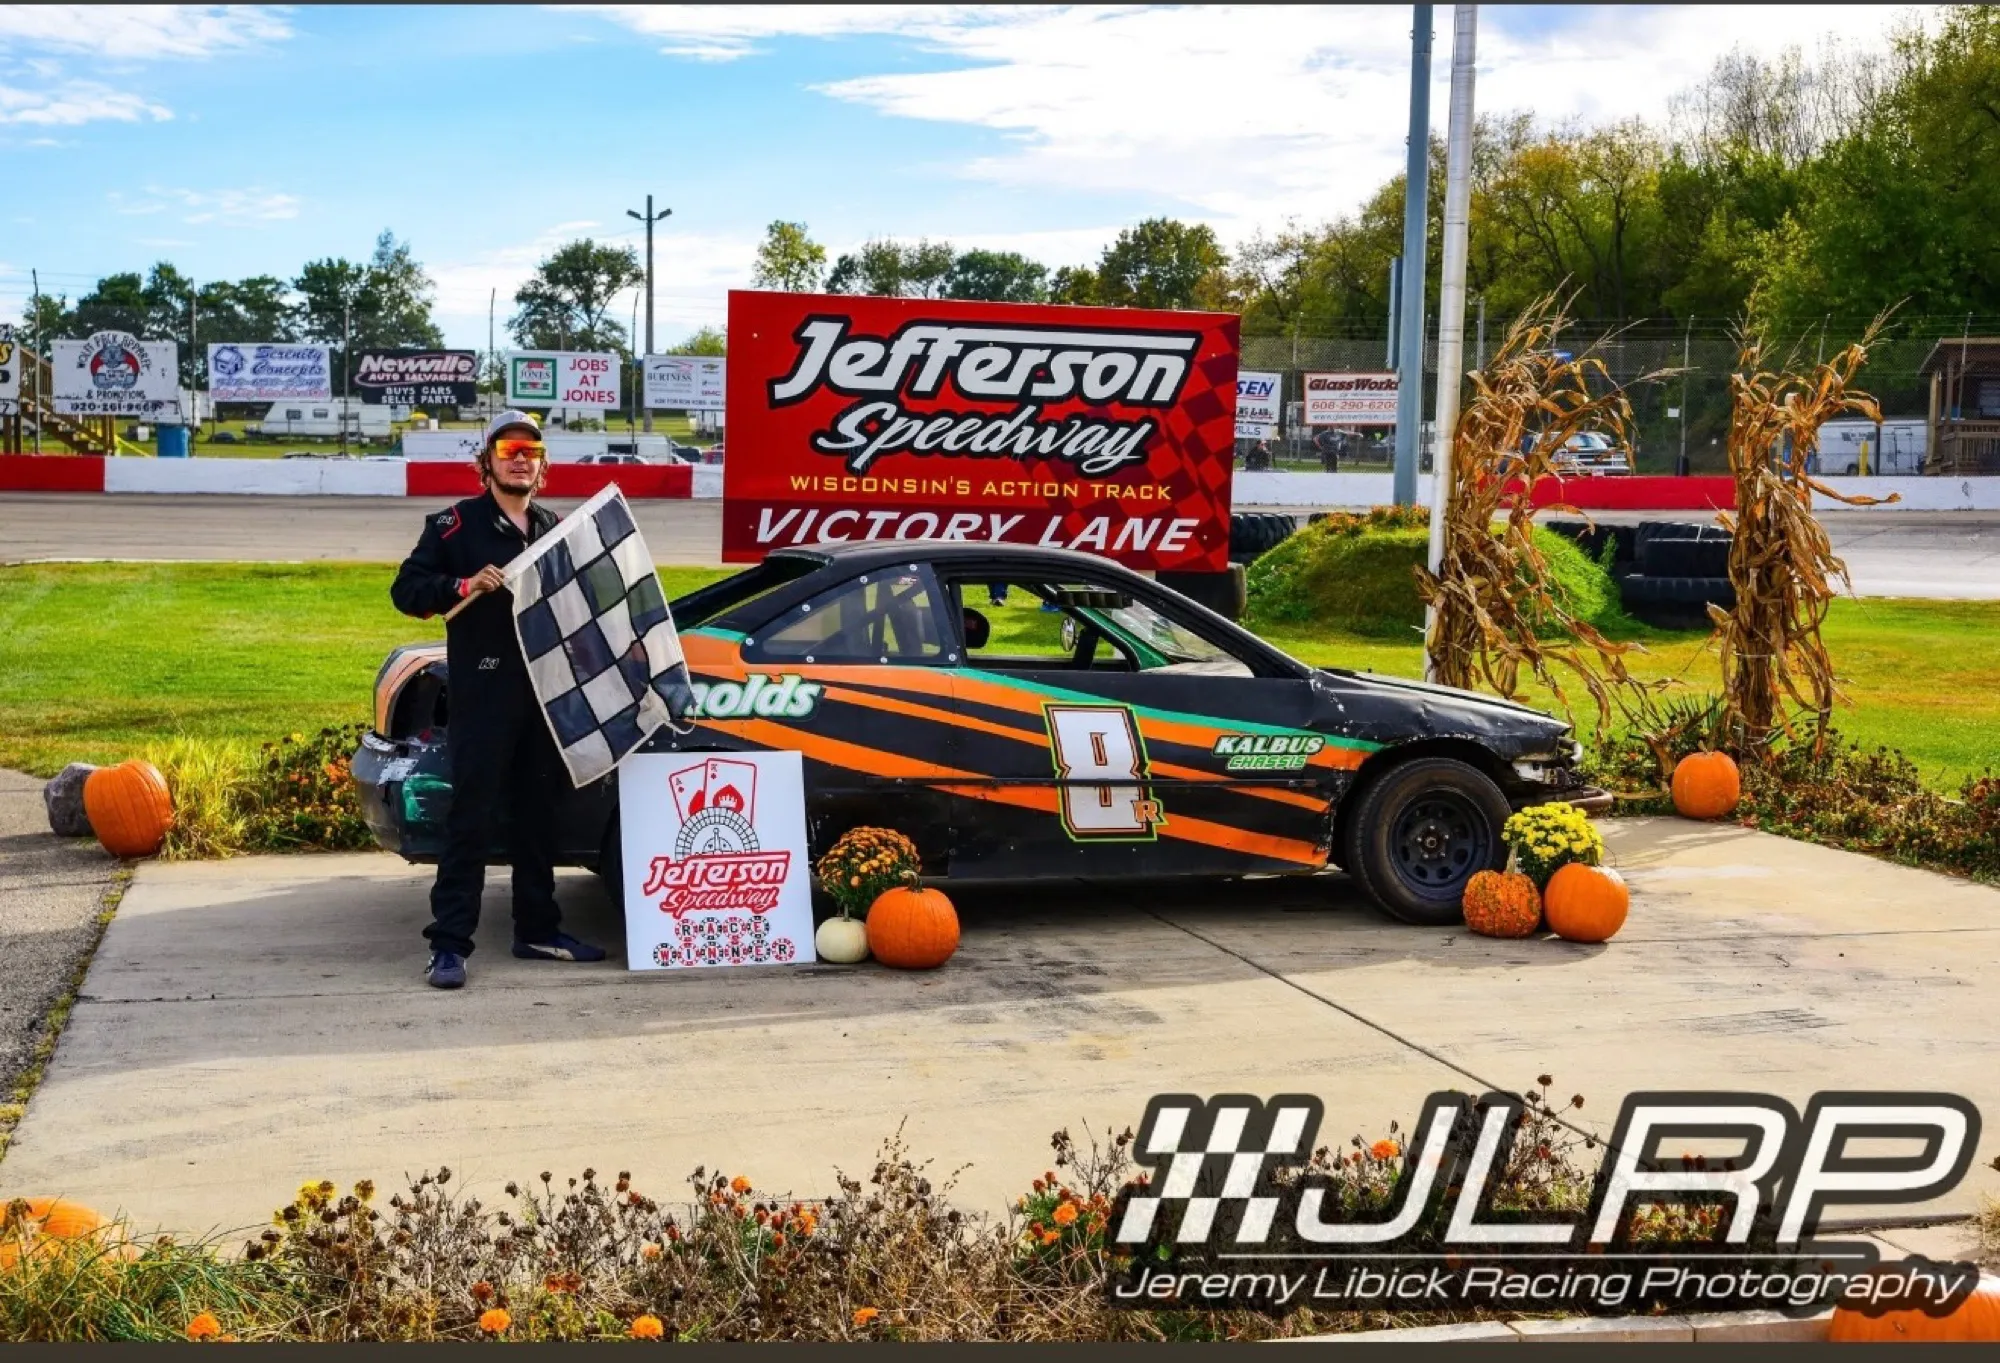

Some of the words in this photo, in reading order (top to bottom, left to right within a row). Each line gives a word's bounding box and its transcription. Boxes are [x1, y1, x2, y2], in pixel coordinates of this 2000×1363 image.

[254, 346, 323, 361] Serenity
[773, 318, 1198, 402] Jefferson
[251, 360, 325, 377] Concepts
[360, 354, 473, 373] Newville
[569, 358, 609, 372] JOBS
[368, 372, 400, 381] AUTO
[404, 373, 455, 382] SALVAGE
[520, 370, 551, 380] JONES
[578, 374, 600, 387] AT
[385, 386, 416, 395] BUYS
[422, 386, 452, 395] CARS
[562, 389, 616, 403] JONES
[381, 395, 416, 404] SELLS
[420, 395, 458, 404] PARTS
[815, 401, 1152, 474] Speedway
[1236, 426, 1261, 436] ILLS
[790, 475, 971, 495] WISCONSIN'S
[982, 480, 1078, 498] ACTION
[1090, 483, 1172, 501] TRACK
[755, 508, 1026, 544] VICTORY
[1038, 514, 1201, 551] LANE
[1215, 736, 1324, 754] KALBUS
[1045, 705, 1148, 833] 8
[1226, 755, 1307, 770] CHASSIS
[645, 852, 790, 895] Jefferson
[661, 887, 779, 918] Speedway
